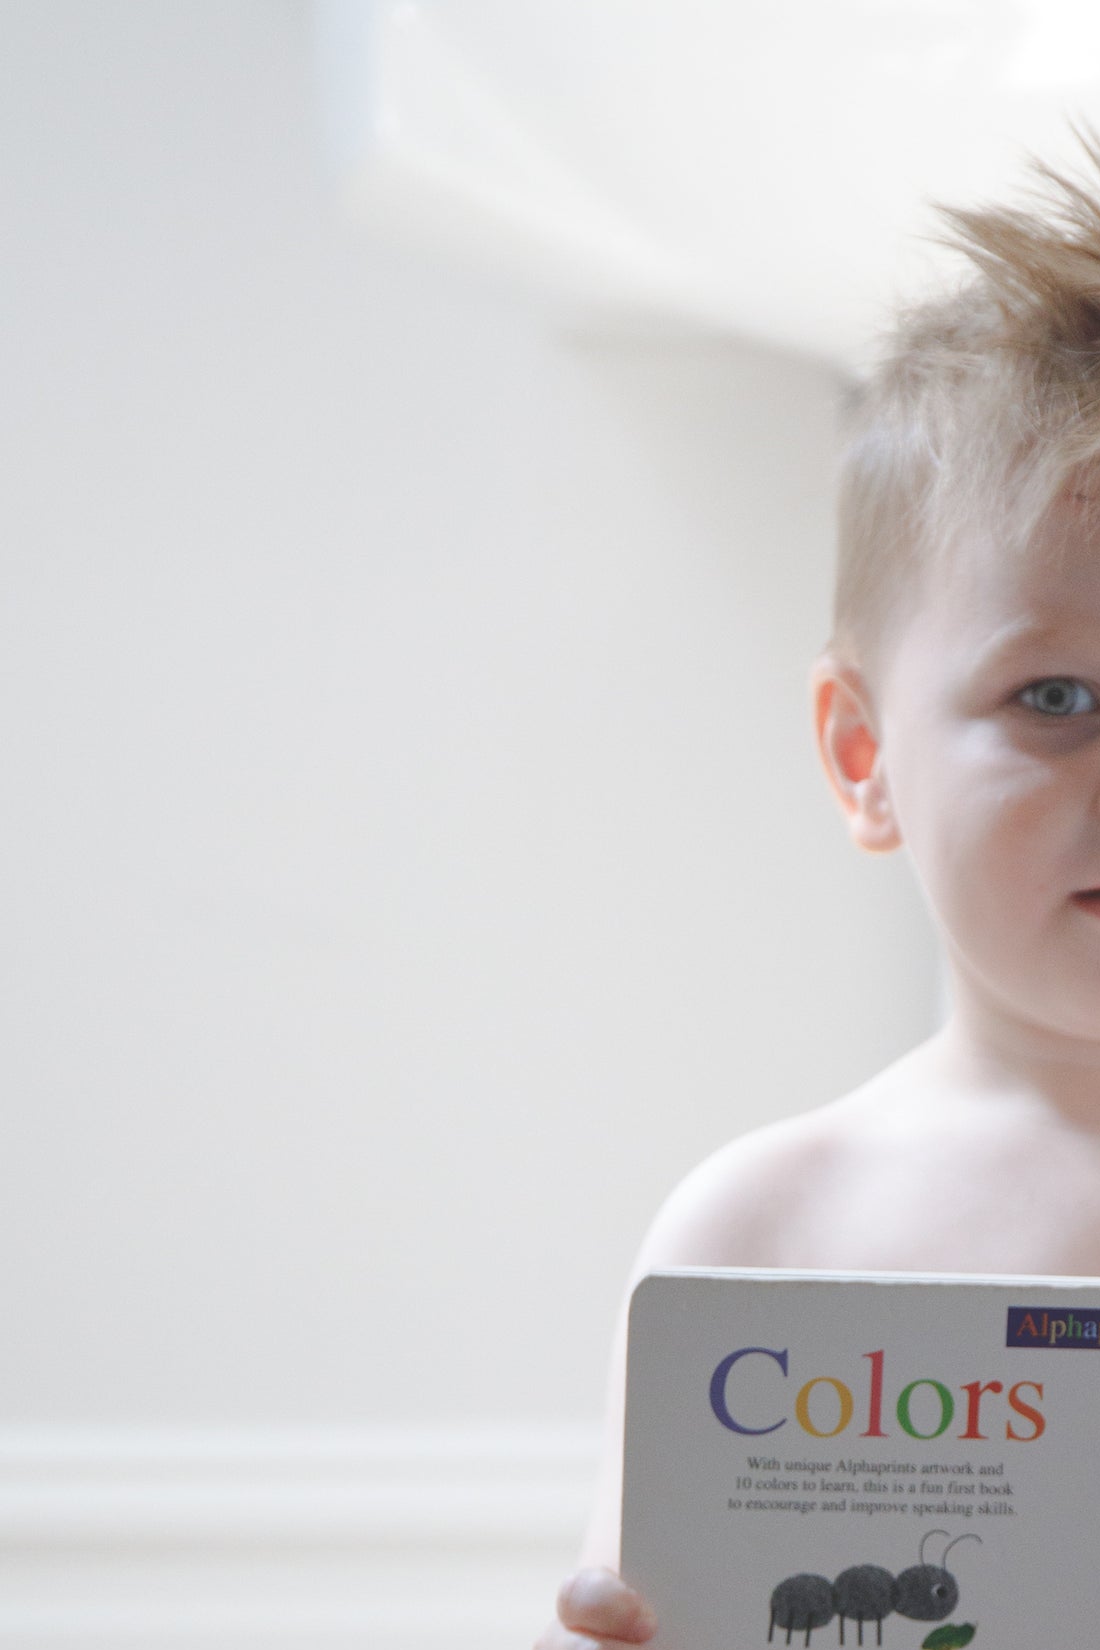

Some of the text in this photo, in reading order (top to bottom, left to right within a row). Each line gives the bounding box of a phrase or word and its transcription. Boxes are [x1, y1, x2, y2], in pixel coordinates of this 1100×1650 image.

[708, 1347, 1047, 1442] Colors
[747, 1456, 1004, 1476] With unique Alphaprints artwork and
[735, 1476, 1014, 1496] 10 colors to learn, this is a fun first book
[727, 1498, 1018, 1517] to encourage and improve speaking skills.
